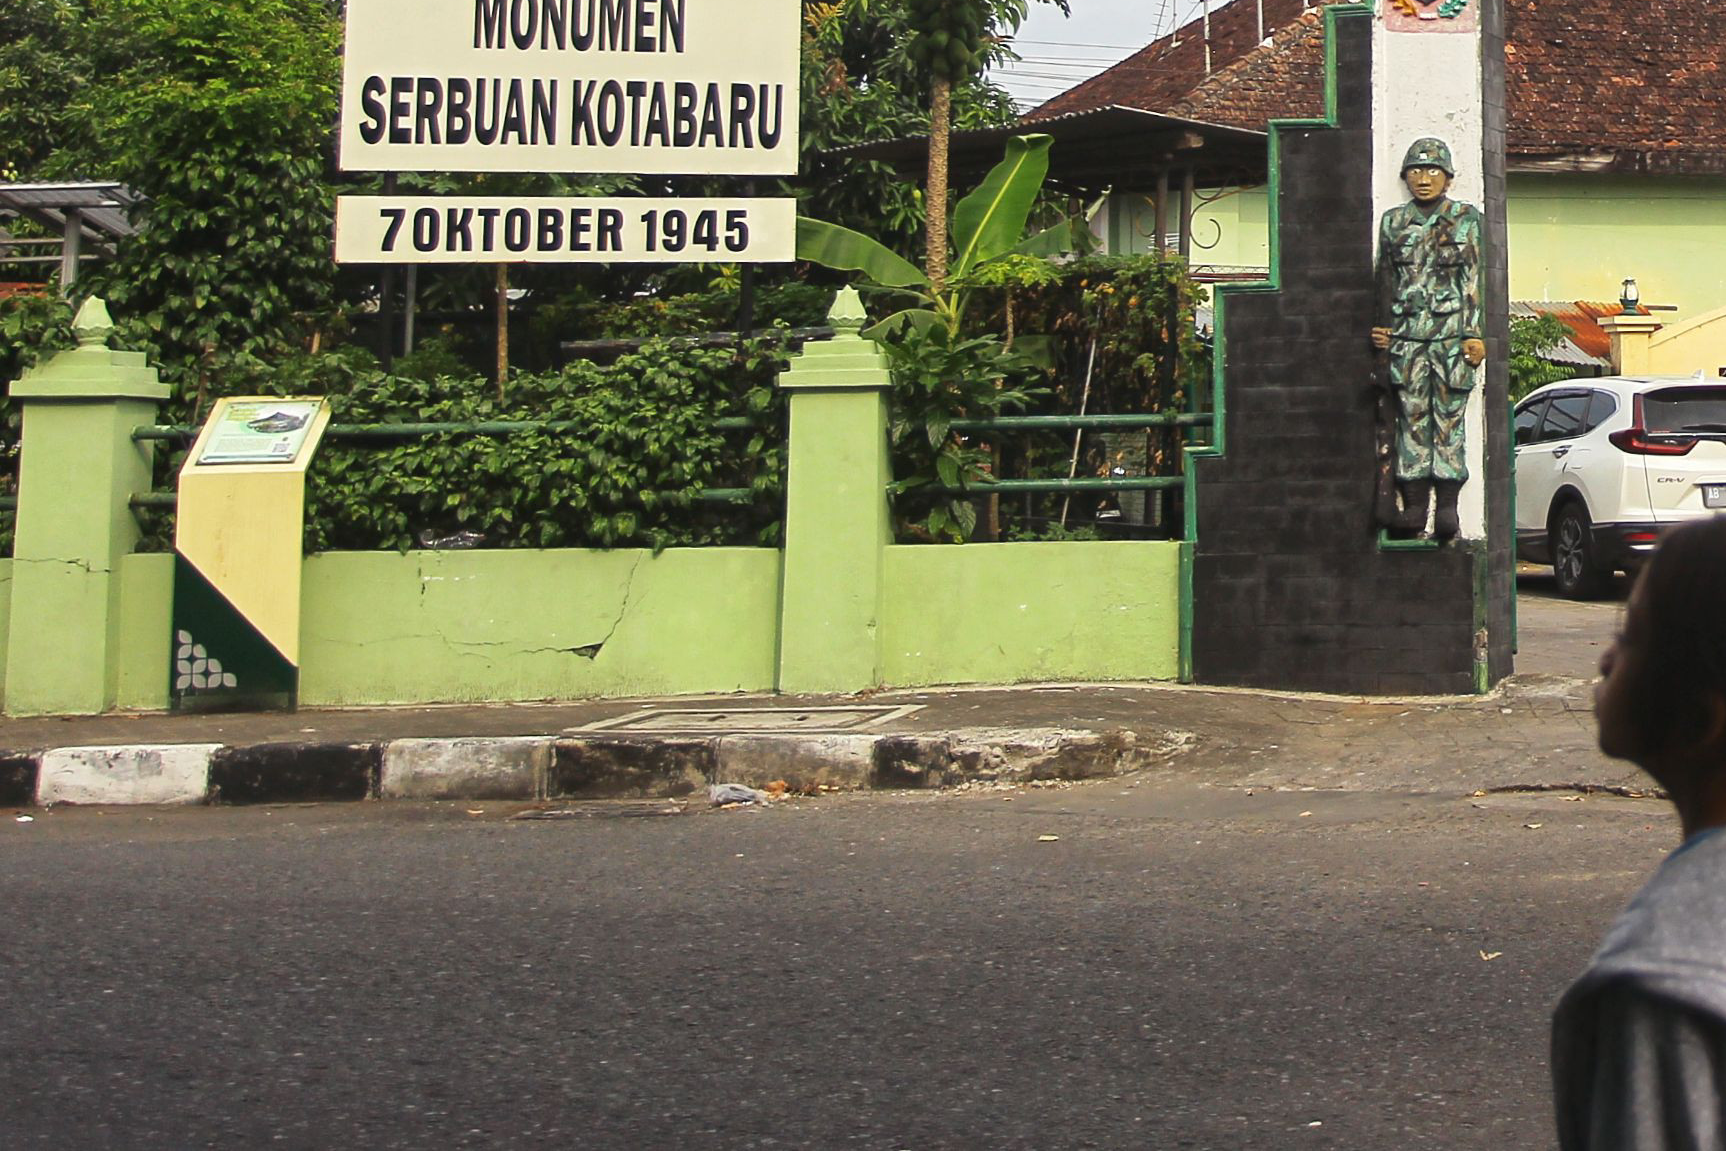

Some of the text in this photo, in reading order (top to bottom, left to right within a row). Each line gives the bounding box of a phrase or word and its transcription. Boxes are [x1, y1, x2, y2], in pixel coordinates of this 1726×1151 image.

[359, 75, 783, 149] SERBUAN KOTABARU
[640, 208, 749, 252] 1945
[1708, 487, 1720, 499] AB
